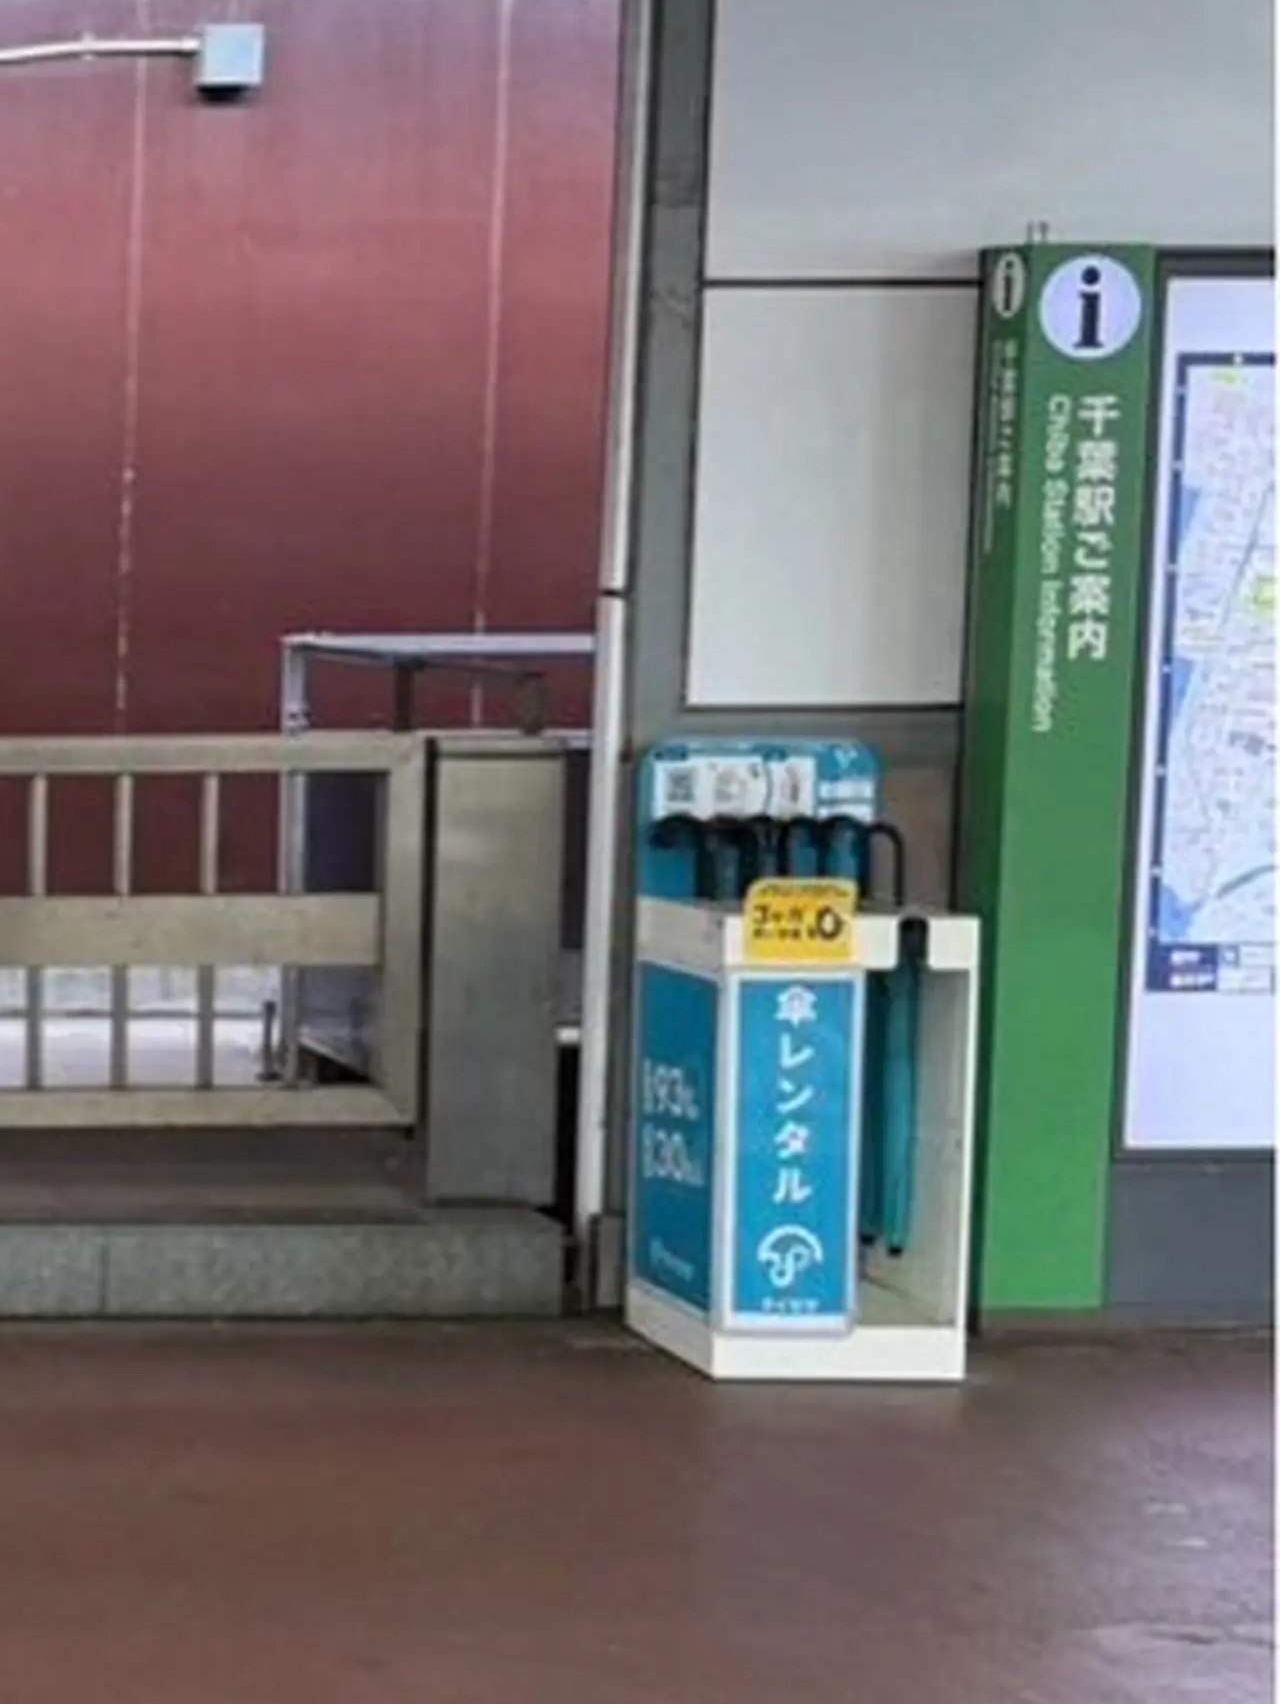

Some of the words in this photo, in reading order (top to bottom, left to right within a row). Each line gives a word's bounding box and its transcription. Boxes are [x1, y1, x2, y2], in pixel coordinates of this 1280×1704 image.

[1040, 479, 1070, 574] Station
[1066, 394, 1121, 661] 千葉駅ご案内
[1032, 580, 1064, 732] Information
[773, 984, 819, 1204] 傘レンタル
